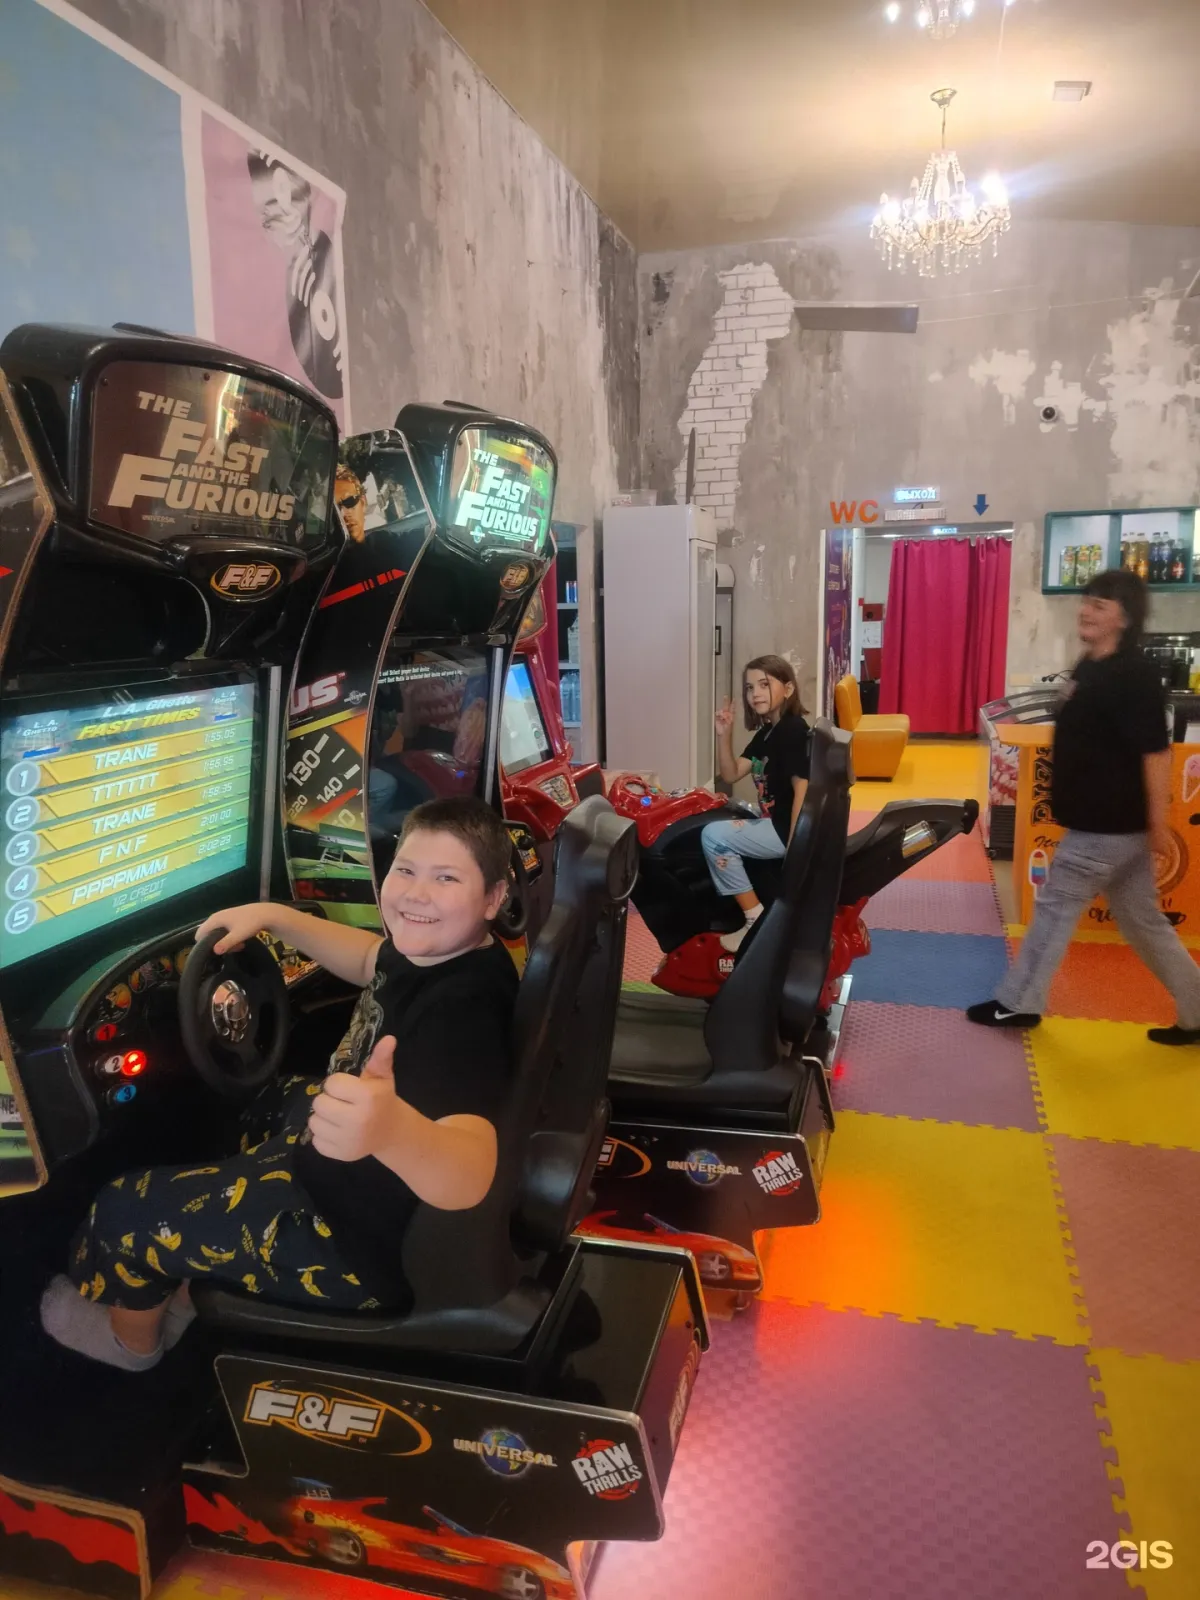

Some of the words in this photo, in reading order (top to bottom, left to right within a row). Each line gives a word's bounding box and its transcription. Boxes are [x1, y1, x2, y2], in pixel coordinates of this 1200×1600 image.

[137, 390, 193, 419] THE
[159, 416, 269, 474] FAST
[473, 449, 499, 466] THE
[107, 453, 296, 521] FURIOUS
[173, 463, 217, 481] AND
[218, 469, 250, 487] THE
[481, 465, 531, 503] FAST
[455, 490, 539, 537] FURIOUS
[485, 496, 506, 511] AND
[506, 501, 521, 512] THE
[829, 499, 879, 524] WC
[220, 565, 274, 589] F&F
[77, 717, 139, 741] FAST
[143, 707, 201, 729] TIMES
[19, 770, 29, 788] 1
[94, 742, 159, 770] TRANE
[287, 749, 320, 787] 130
[13, 804, 31, 825] 2
[92, 772, 160, 803] TTTTTT
[316, 776, 343, 804] 140
[12, 839, 30, 860] 3
[92, 802, 158, 835] TRANE
[12, 907, 29, 928] 5
[72, 855, 169, 905] PPPPMMM
[13, 873, 29, 892] 4
[718, 959, 735, 968] RA
[112, 1056, 120, 1072] 2
[666, 1160, 742, 1176] UNIVERSAL
[752, 1151, 797, 1184] RAW
[760, 1167, 804, 1194] THRILLS
[245, 1385, 385, 1438] F&F
[453, 1438, 558, 1468] UNIVERSAL
[571, 1442, 634, 1482] RAW
[582, 1465, 642, 1496] THRILLS
